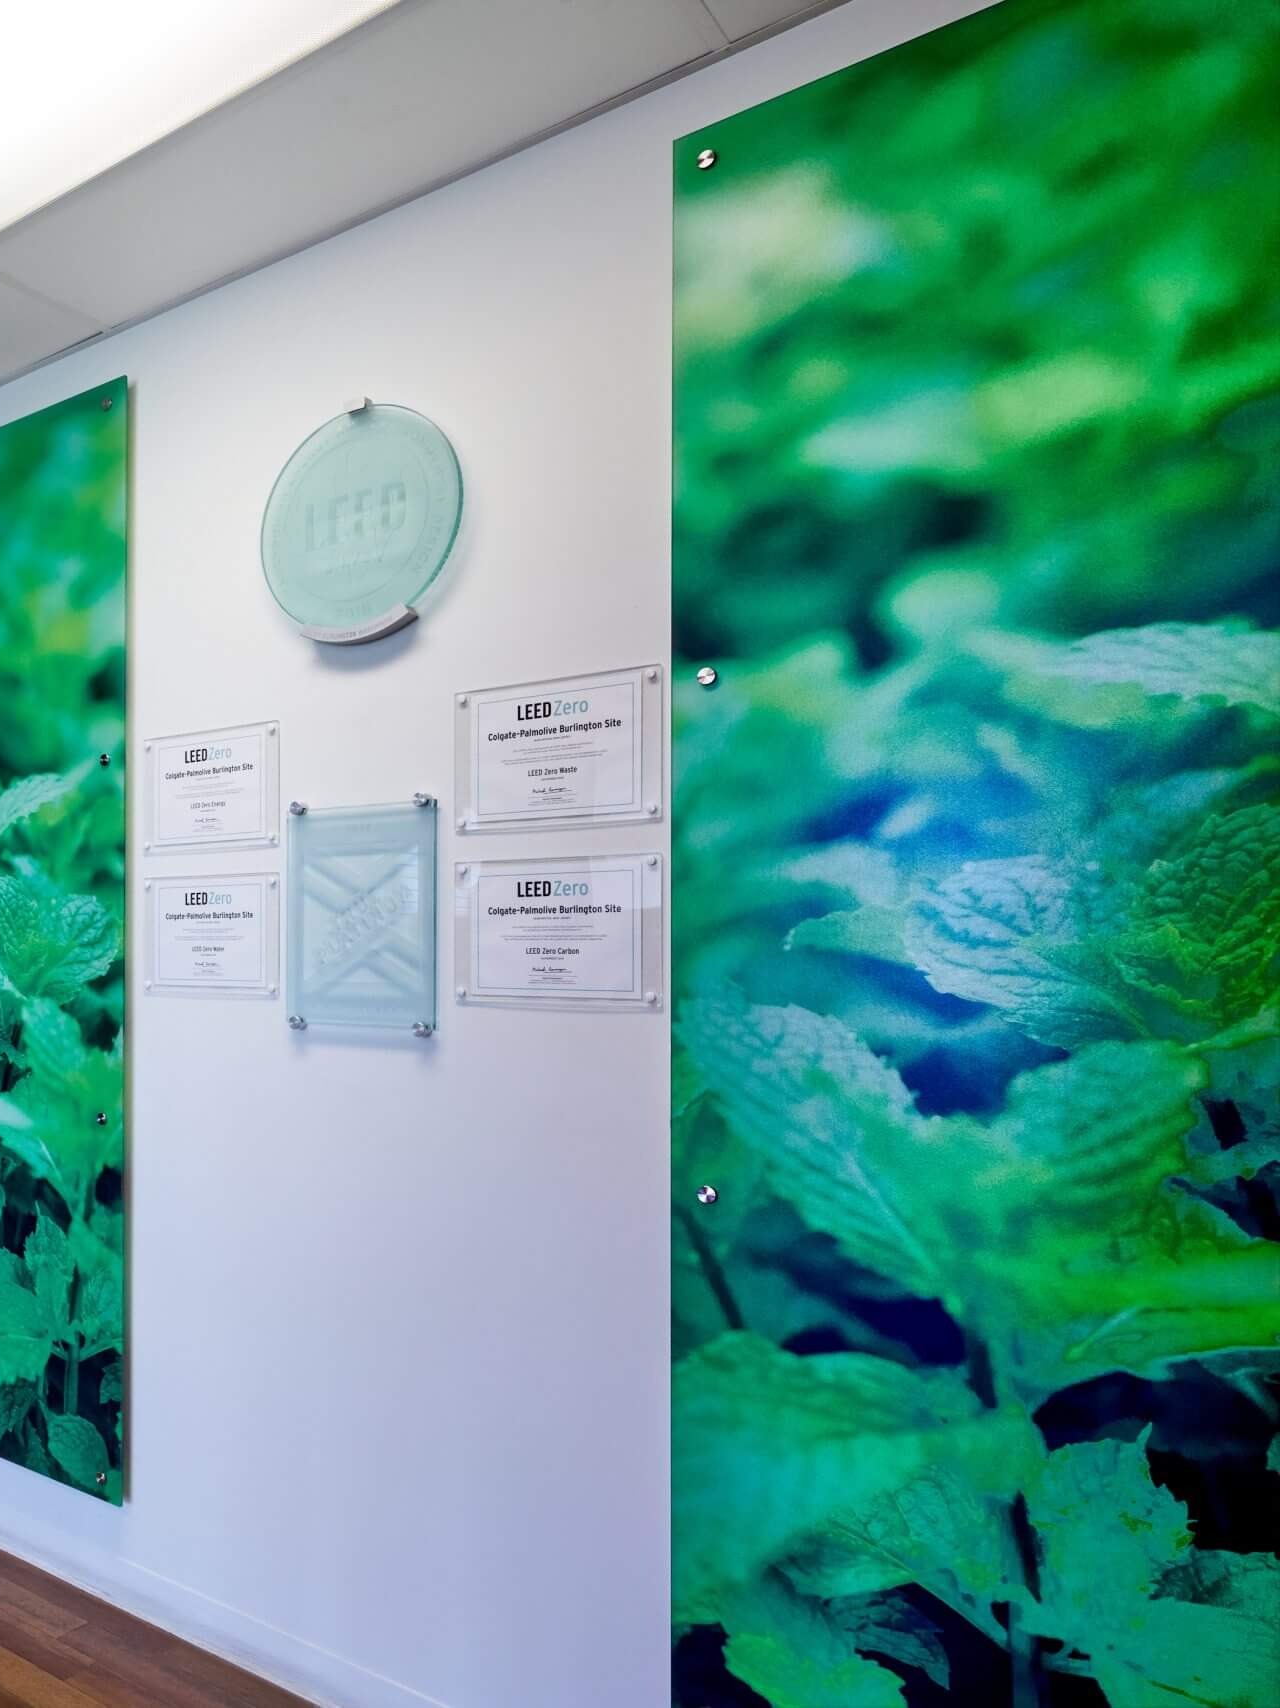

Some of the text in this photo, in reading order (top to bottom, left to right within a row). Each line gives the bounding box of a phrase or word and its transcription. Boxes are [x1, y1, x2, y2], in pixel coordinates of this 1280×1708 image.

[488, 726, 557, 742] Colgate-Palmolive
[559, 721, 602, 733] Burlington
[604, 718, 622, 728] Site
[165, 768, 211, 780] Colgate-Palmolive
[212, 765, 241, 774] Burlington
[242, 763, 253, 771] Site
[527, 769, 543, 777] LEED
[559, 766, 578, 774] Waste
[165, 911, 254, 920] Colgate-Palmolive Burlington Site
[488, 904, 622, 917] Colgate-Palmolive Burlington Site
[525, 947, 580, 955] LEED Zero Carbon
